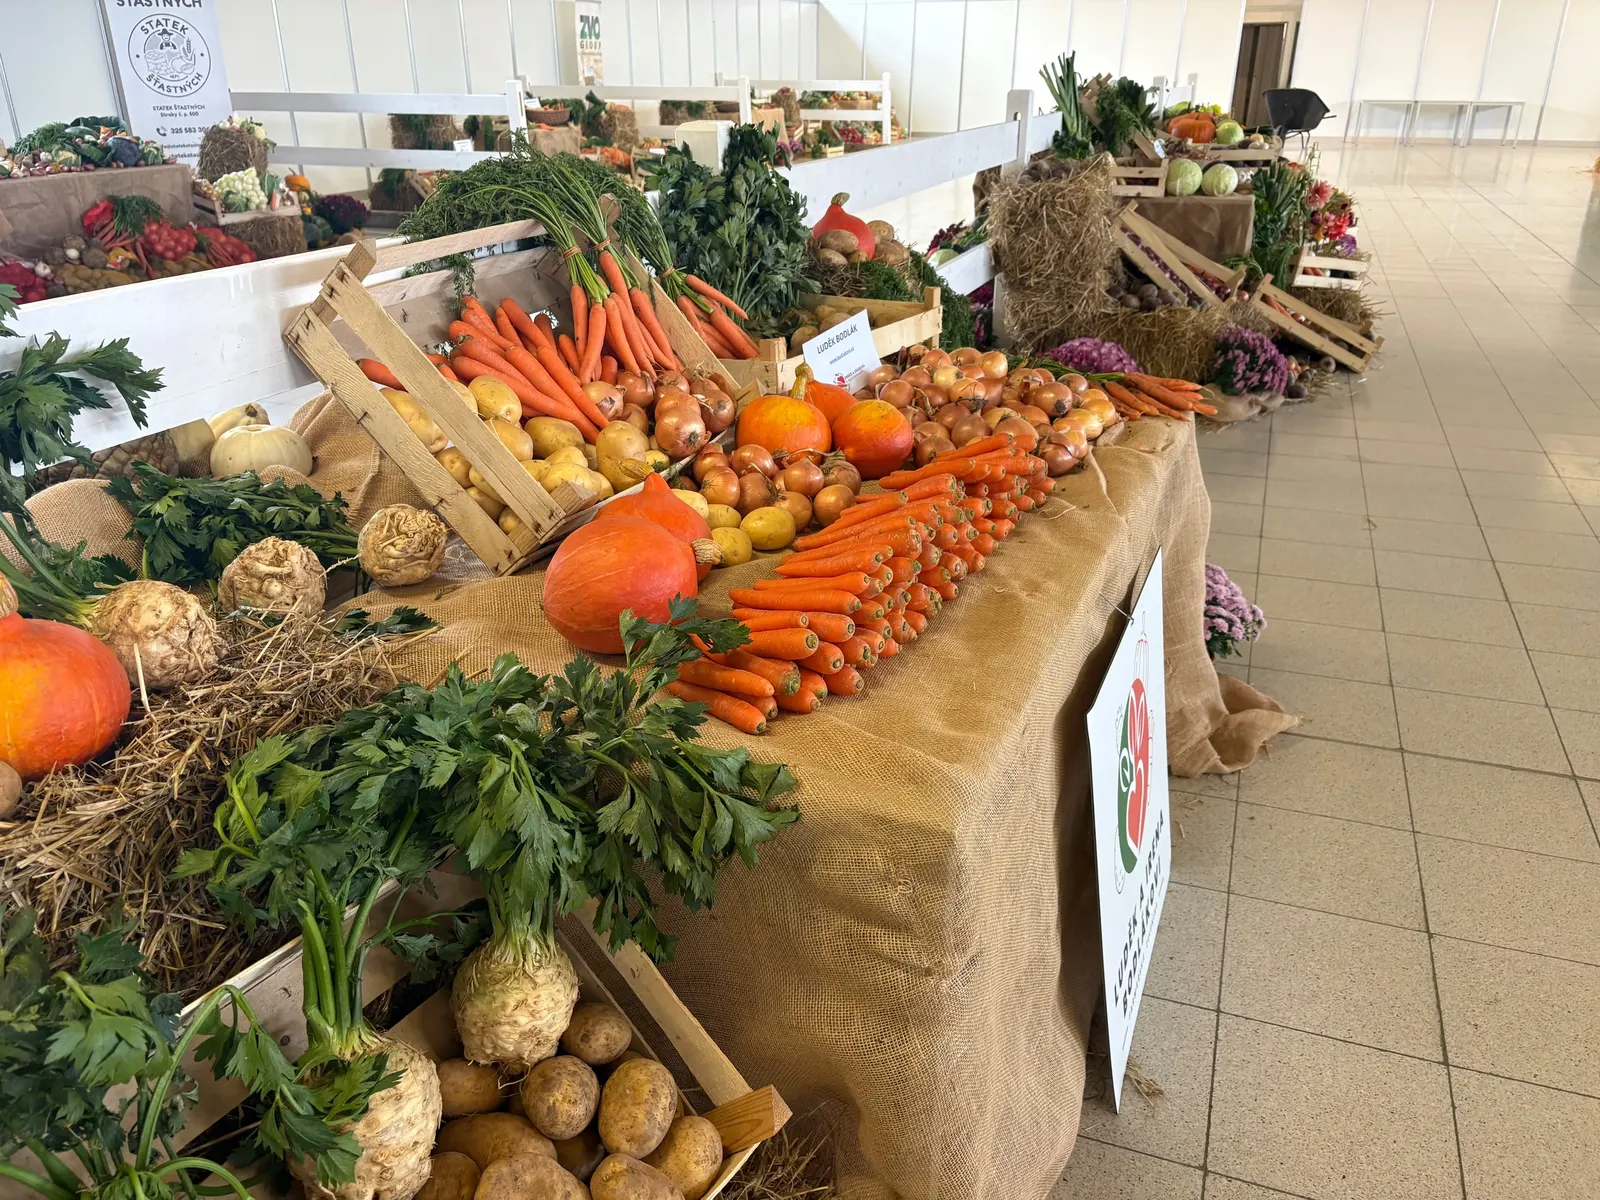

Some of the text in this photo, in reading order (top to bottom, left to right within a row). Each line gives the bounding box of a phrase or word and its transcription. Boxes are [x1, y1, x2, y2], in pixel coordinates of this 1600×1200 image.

[140, 18, 189, 35] STATEK
[580, 15, 601, 40] ZVO
[146, 72, 203, 94] ŠŤASTNÝCH
[816, 323, 858, 354] LUDĚK BODLÁK
[1113, 904, 1138, 1008] LUDĚK
[1139, 883, 1145, 909] A
[1145, 808, 1164, 884] IRENA
[1122, 855, 1162, 1018] BODLÁKOVI
